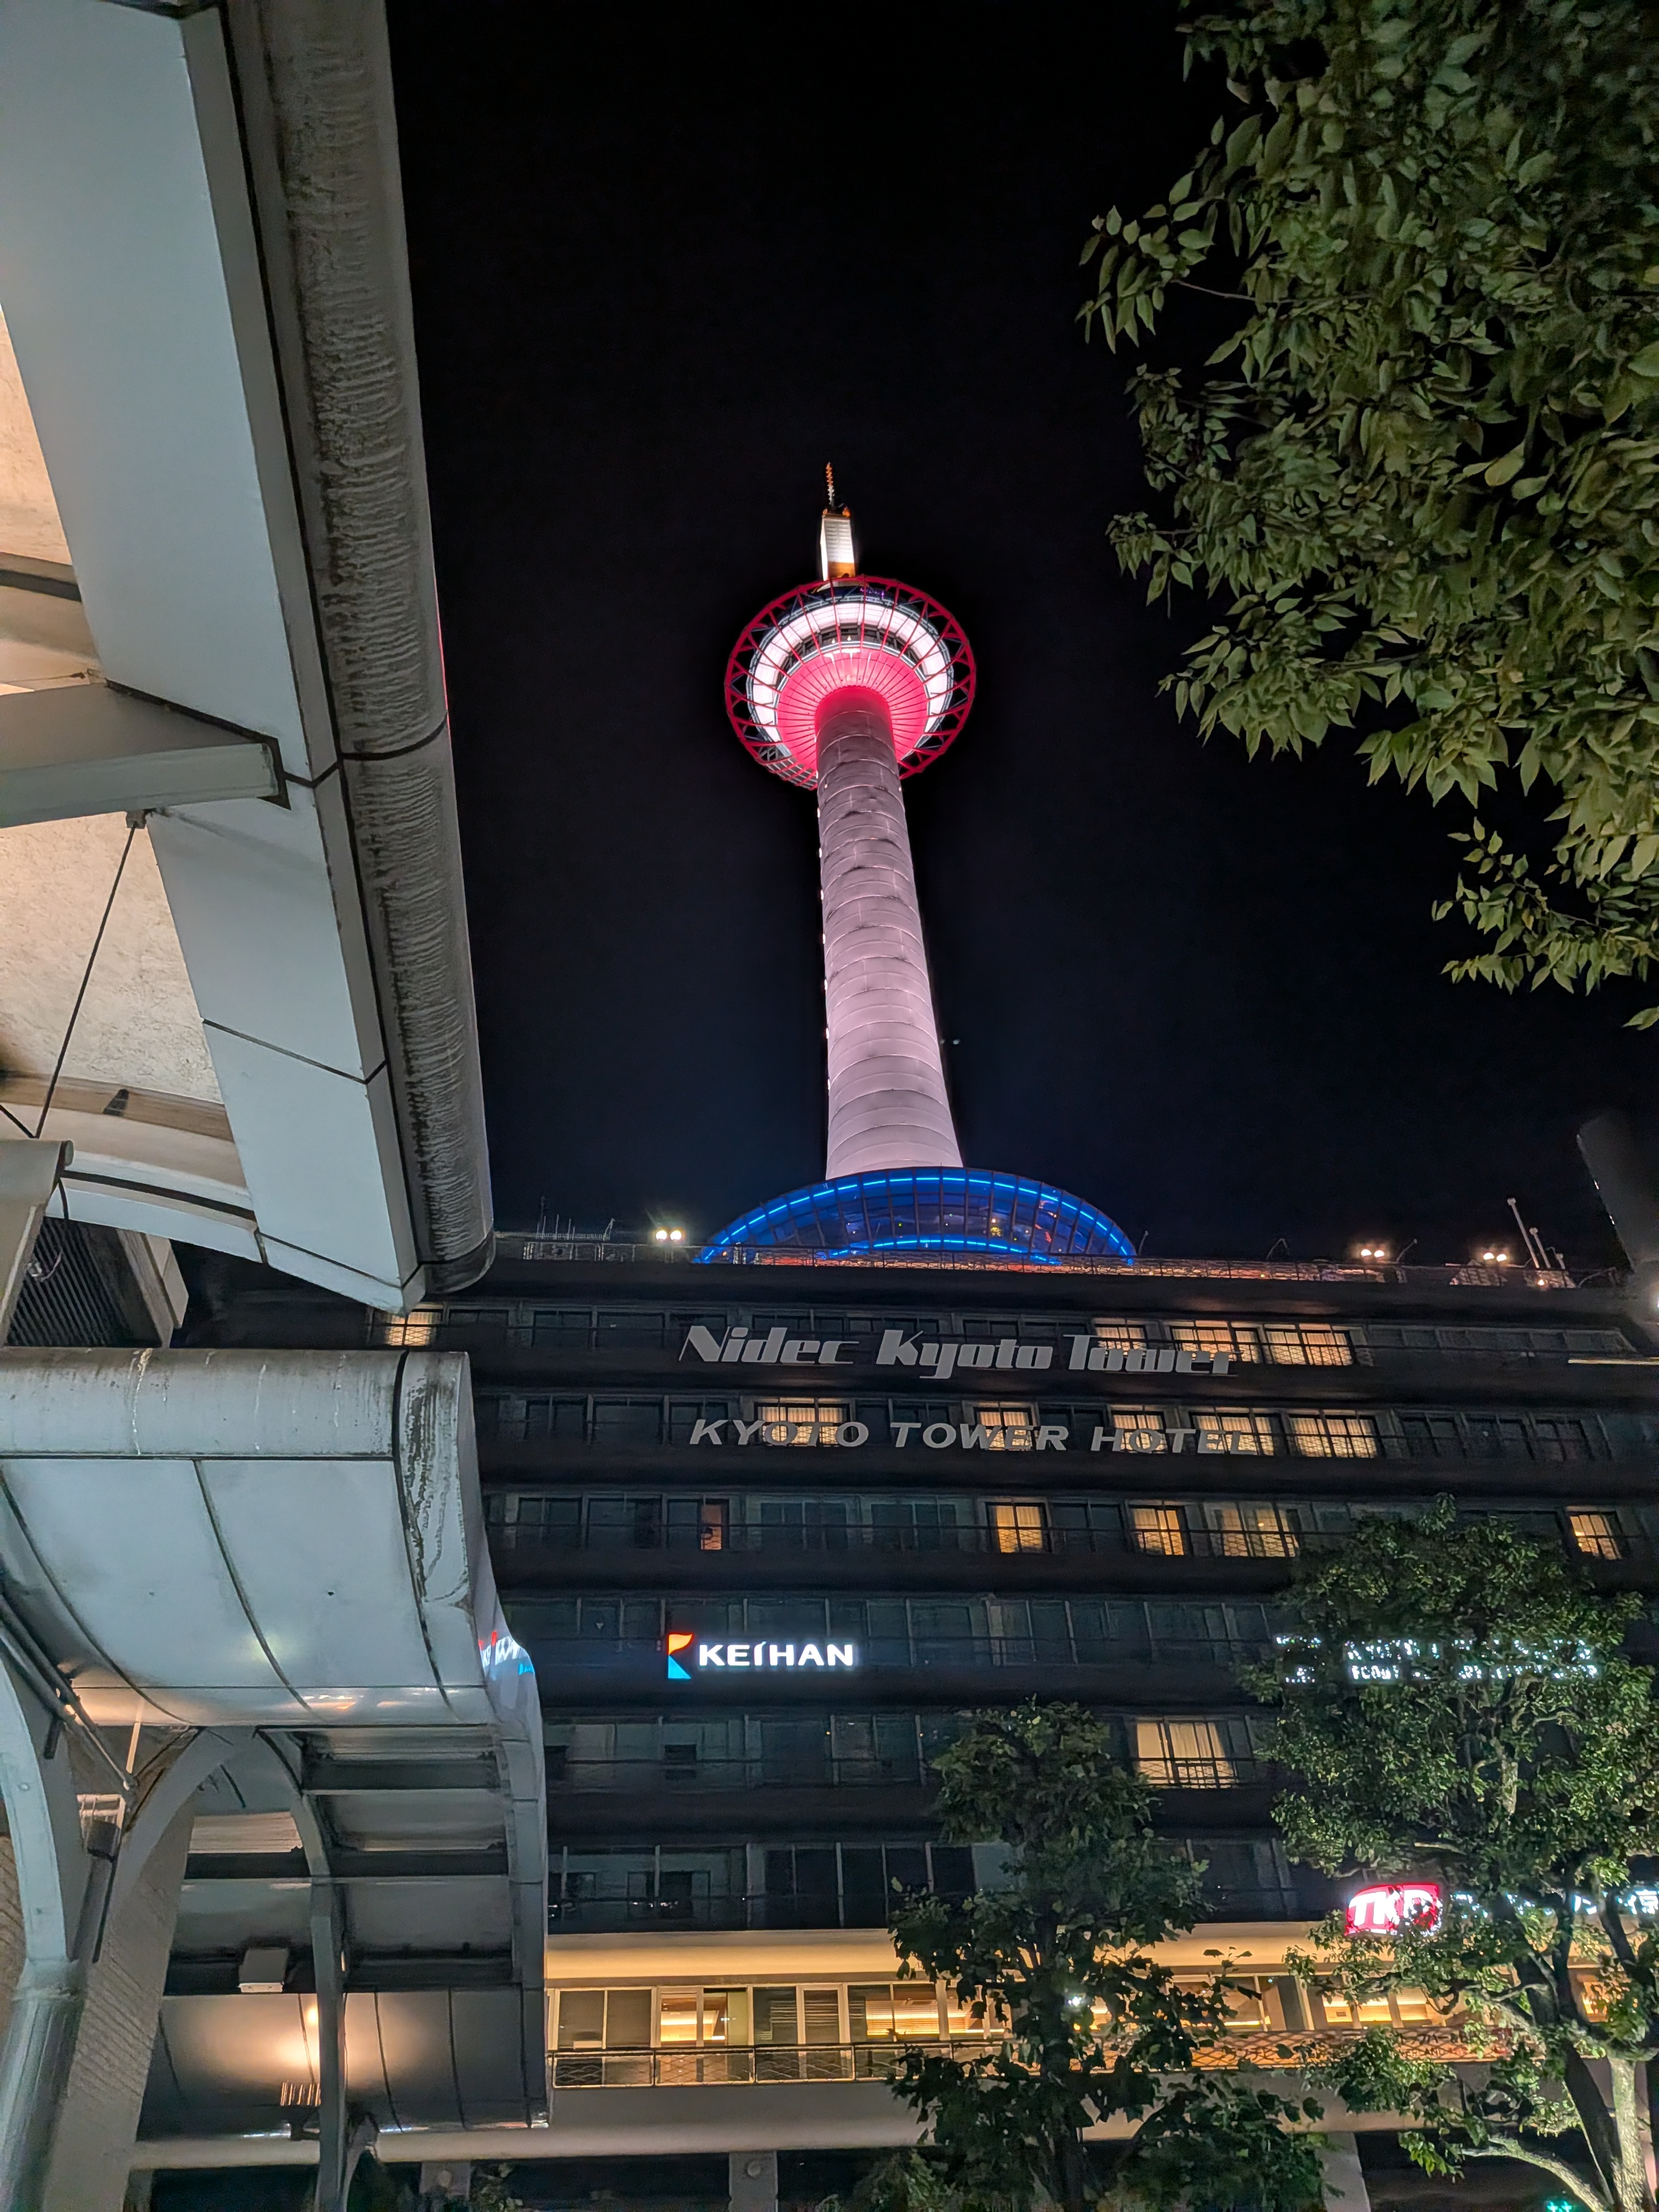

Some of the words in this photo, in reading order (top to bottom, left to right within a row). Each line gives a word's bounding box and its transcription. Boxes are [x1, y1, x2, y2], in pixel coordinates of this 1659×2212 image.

[679, 1326, 859, 1364] Nidec
[876, 1329, 1053, 1379] Kyoto
[1063, 1334, 1244, 1374] Tower
[690, 1419, 869, 1447] KYOTO
[890, 1422, 1069, 1451] TOWER
[1091, 1426, 1258, 1455] HOTEL
[699, 1641, 853, 1667] KEIHAN
[1348, 1889, 1434, 1927] TKP
